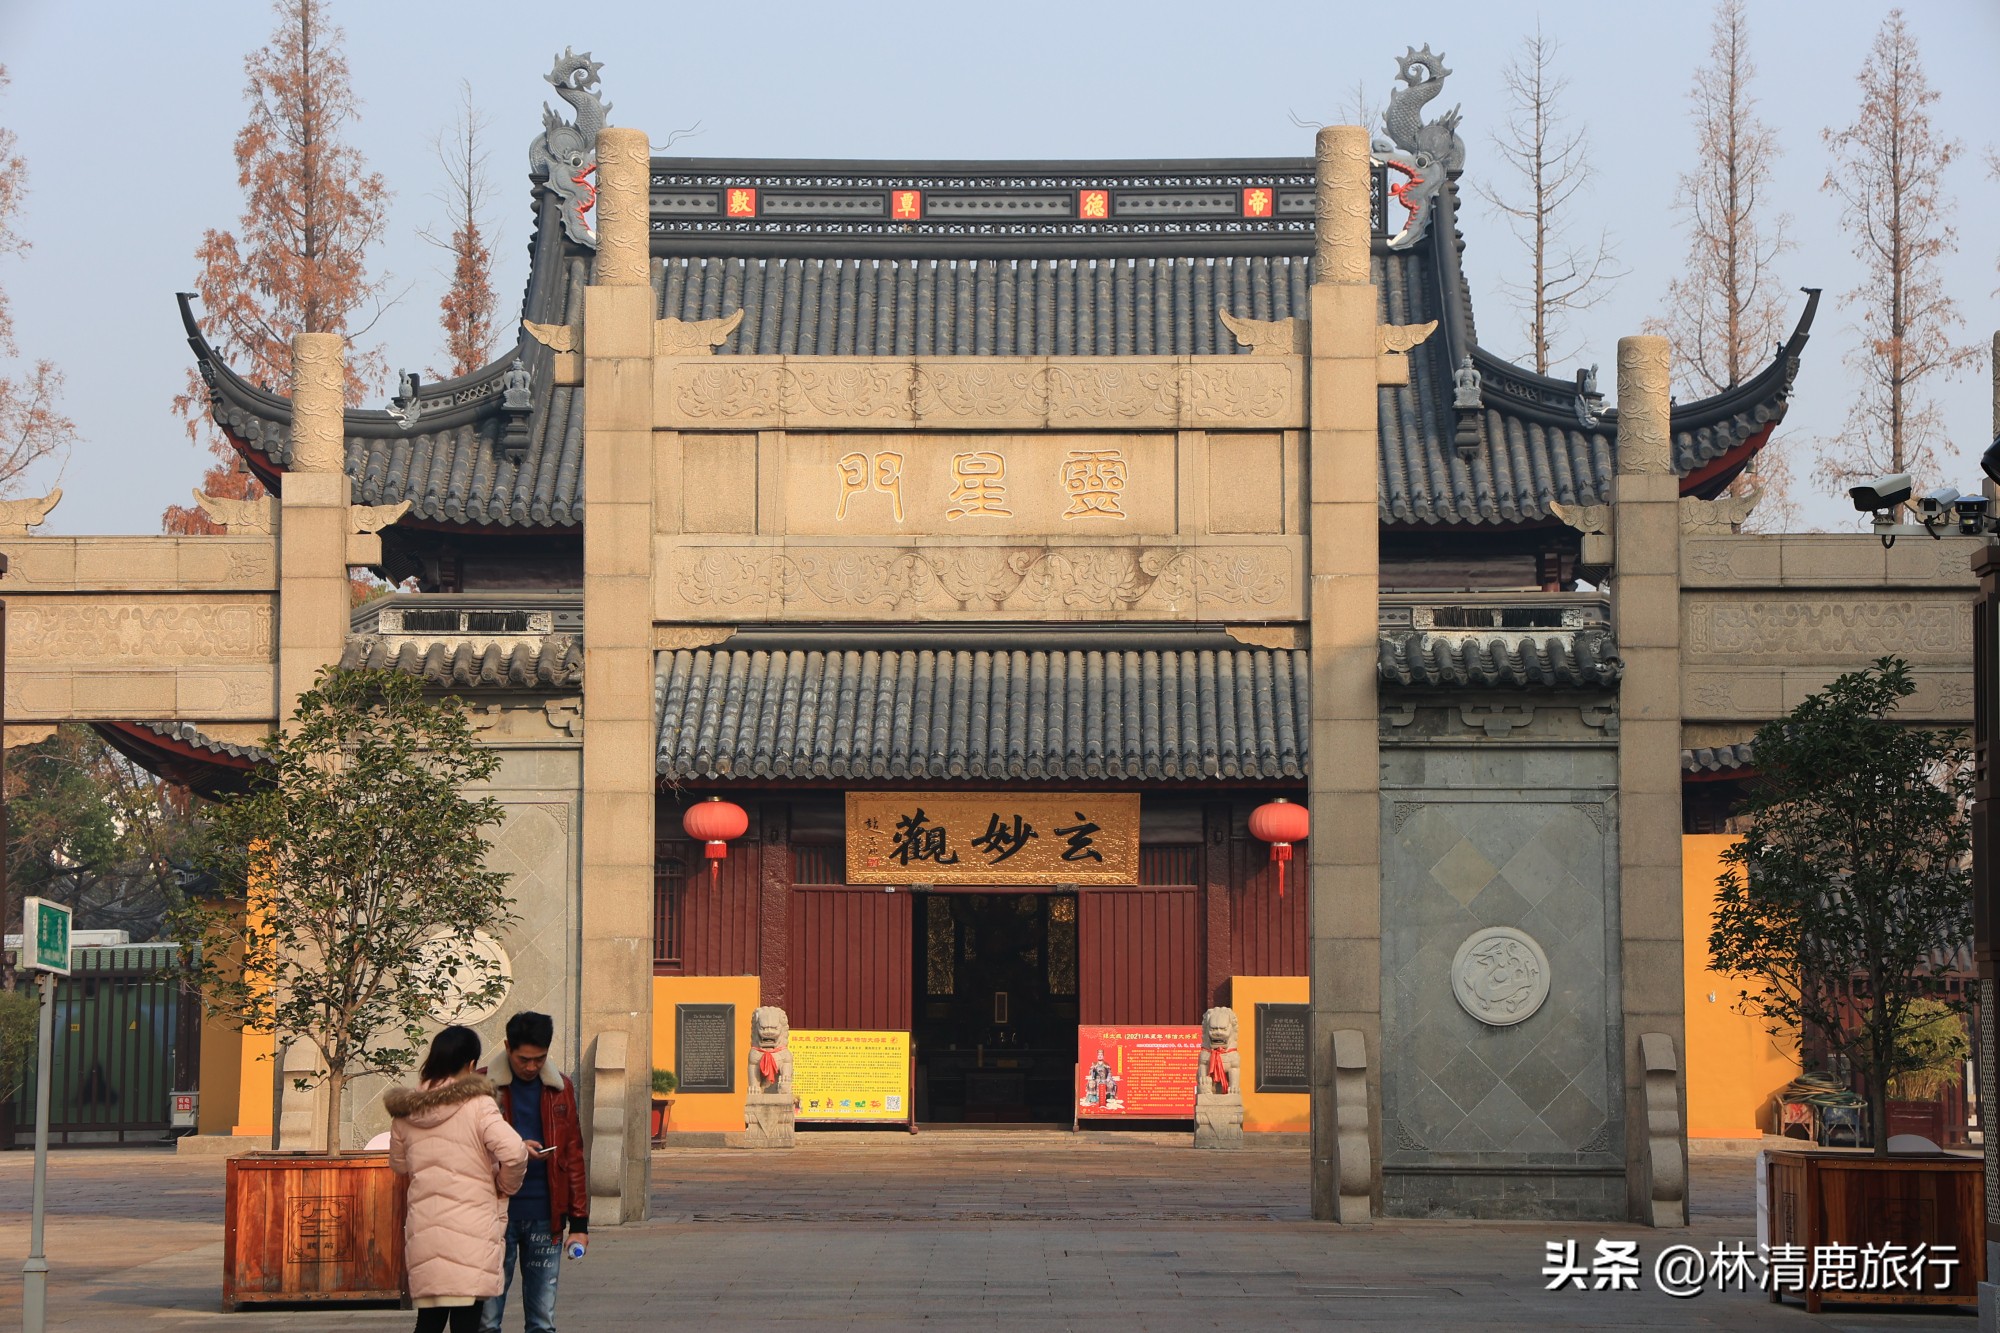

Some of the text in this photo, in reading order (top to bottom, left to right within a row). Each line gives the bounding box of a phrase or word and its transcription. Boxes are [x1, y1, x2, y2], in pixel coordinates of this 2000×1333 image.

[730, 189, 753, 213] 敷
[897, 192, 915, 217] 覃
[1248, 189, 1269, 216] 帝
[888, 807, 1103, 867] 玄妙觀
